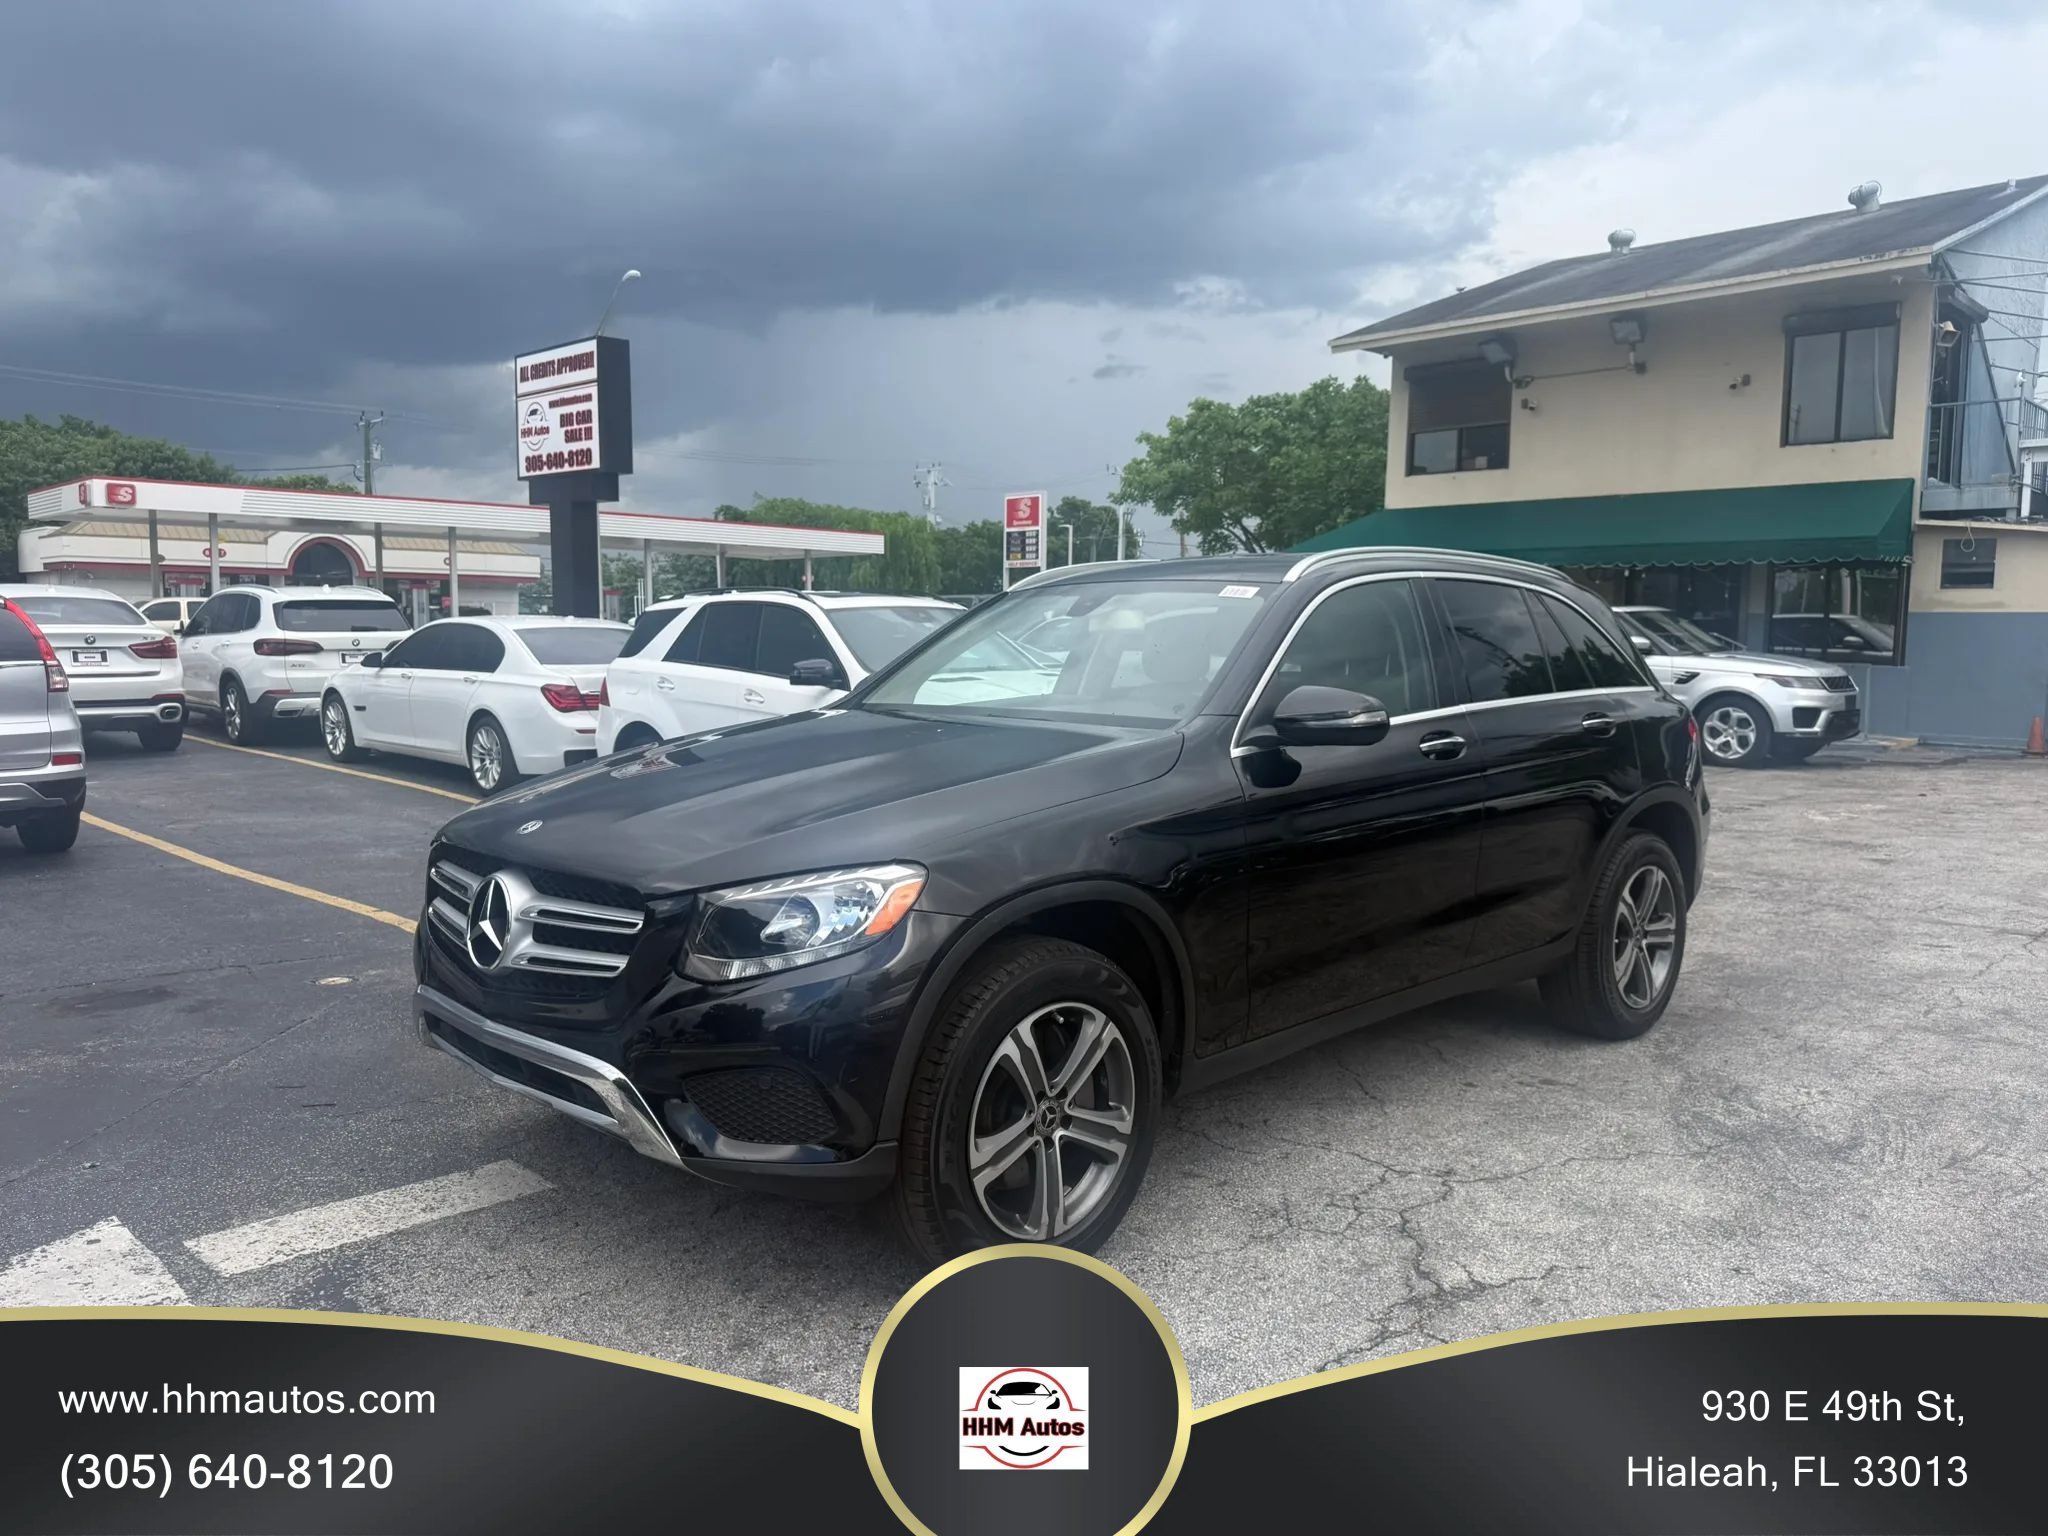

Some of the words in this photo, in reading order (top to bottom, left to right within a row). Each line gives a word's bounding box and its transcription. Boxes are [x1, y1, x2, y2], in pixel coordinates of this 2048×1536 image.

[520, 366, 530, 383] ALL
[530, 359, 556, 380] CREDITS
[560, 413, 574, 428] BIG
[575, 409, 593, 426] CAR
[521, 427, 533, 438] HHM
[534, 426, 549, 436] Autos
[565, 428, 583, 443] SALE
[525, 448, 592, 472] 305-640-8120
[118, 486, 133, 501] S
